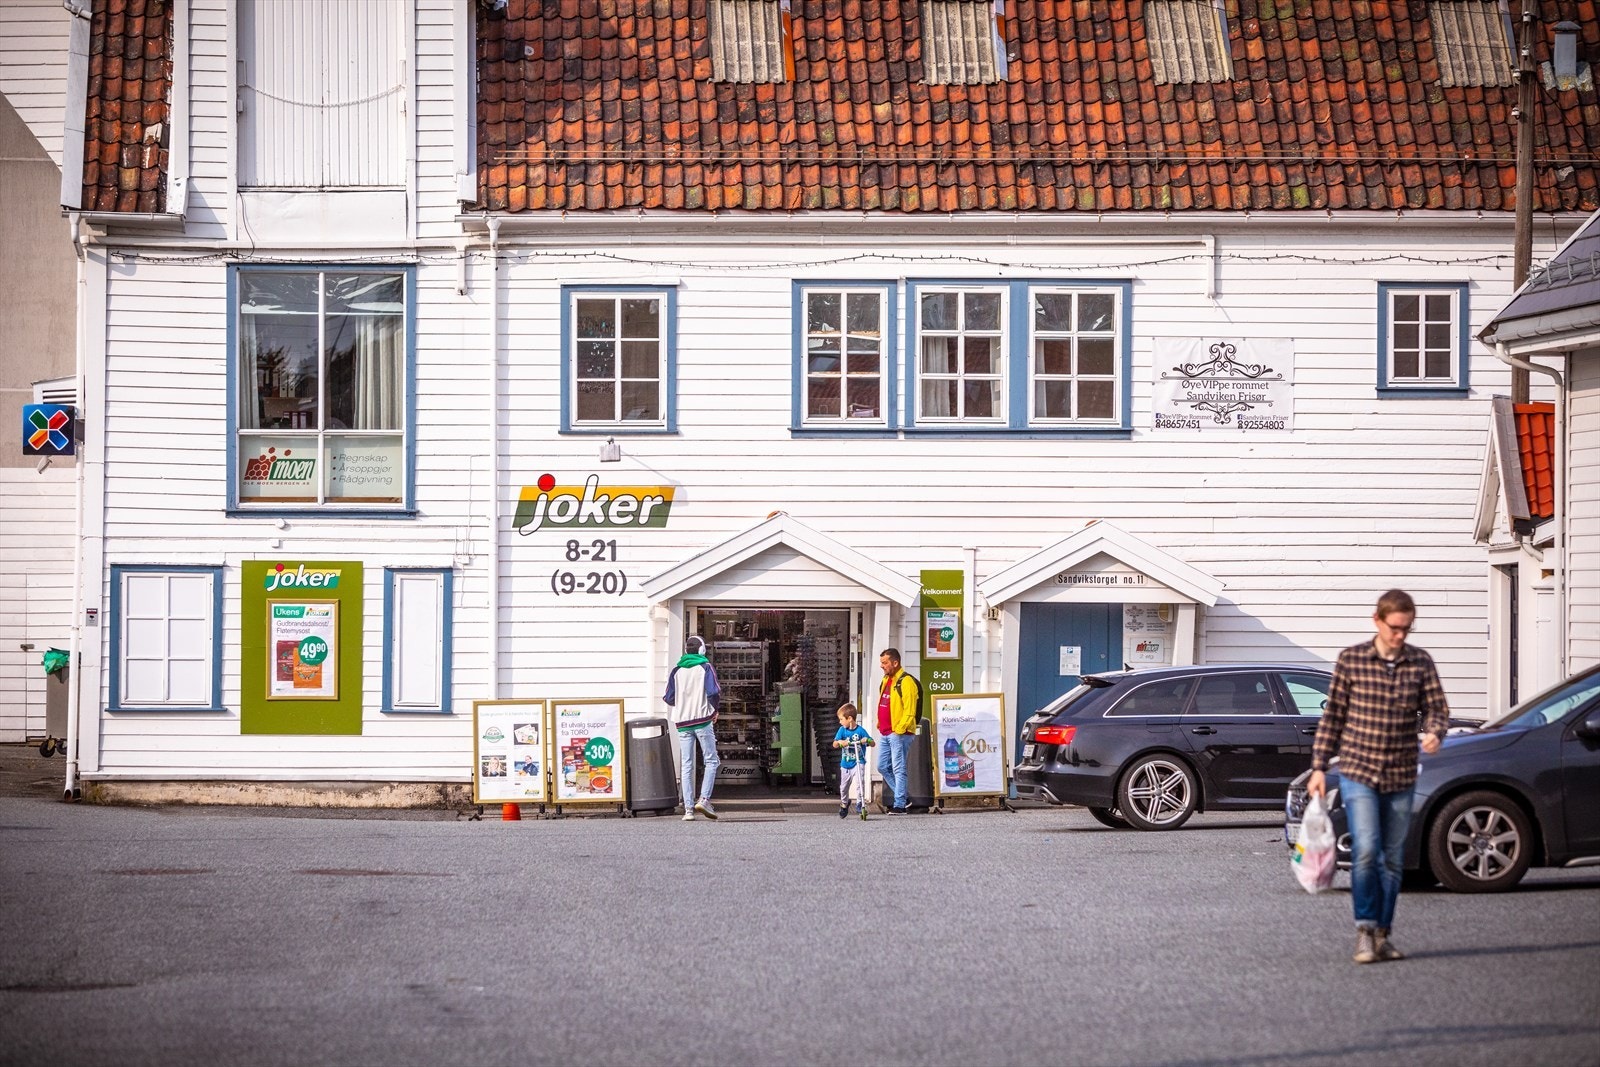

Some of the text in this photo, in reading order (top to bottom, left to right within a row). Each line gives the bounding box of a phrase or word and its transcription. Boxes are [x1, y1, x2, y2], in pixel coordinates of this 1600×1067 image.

[1181, 380, 1269, 392] ØyeVIPpe rommet
[1187, 391, 1266, 401] Sandviken Frisør
[1161, 419, 1200, 429] 48657451
[1244, 420, 1284, 430] 92554803
[339, 454, 388, 464] Regnskap
[273, 459, 313, 480] moen
[339, 464, 393, 474] Årsoppgjør
[339, 475, 394, 485] Rådgivning
[519, 473, 665, 536] joker
[566, 539, 618, 562] 8-21
[266, 563, 337, 592] joker
[551, 569, 628, 596] (9-20)
[1058, 574, 1118, 585] Sandvikstorget
[922, 588, 962, 596] Velkommen!
[276, 608, 300, 616] Ukens
[932, 671, 951, 680] 8-21
[928, 681, 955, 692] (9-20)
[587, 721, 607, 729] supper
[966, 737, 987, 754] 20
[585, 744, 612, 760] -30%
[721, 766, 755, 777] Energizer
